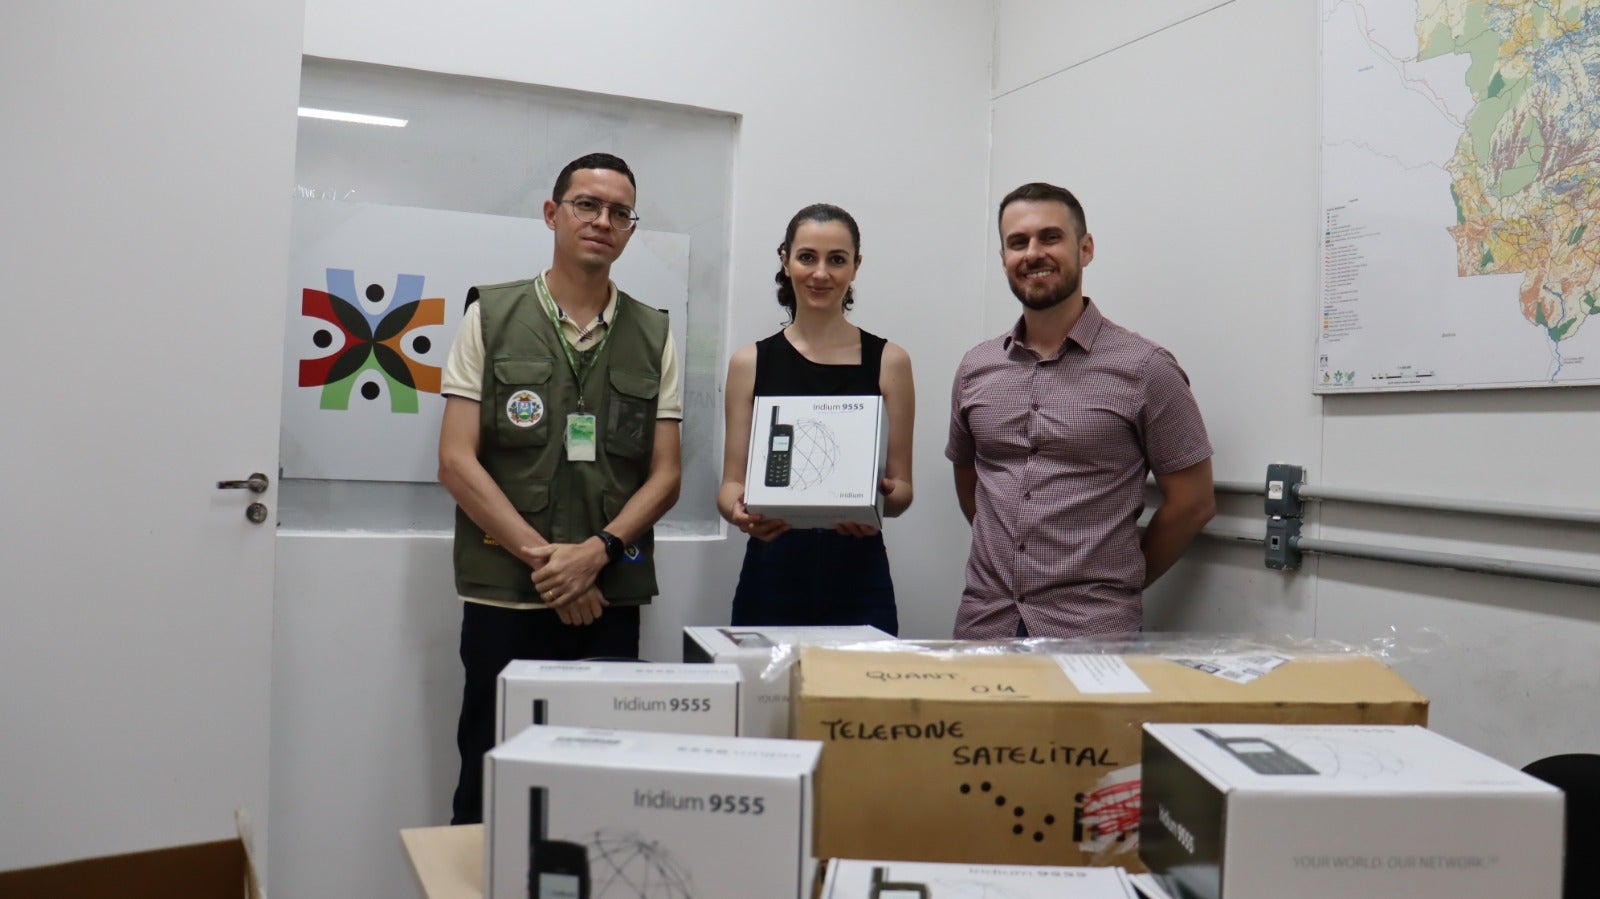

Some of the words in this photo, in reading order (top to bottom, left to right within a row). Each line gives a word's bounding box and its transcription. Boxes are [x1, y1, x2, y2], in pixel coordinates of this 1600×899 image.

[813, 403, 841, 411] Iridium
[613, 697, 666, 711] Iridium
[669, 698, 711, 712] 9555
[820, 719, 965, 741] TELEFONE
[634, 788, 704, 811] Iridium
[709, 794, 765, 815] 9555
[1292, 855, 1330, 869] YOUR
[1386, 855, 1416, 869] OUR
